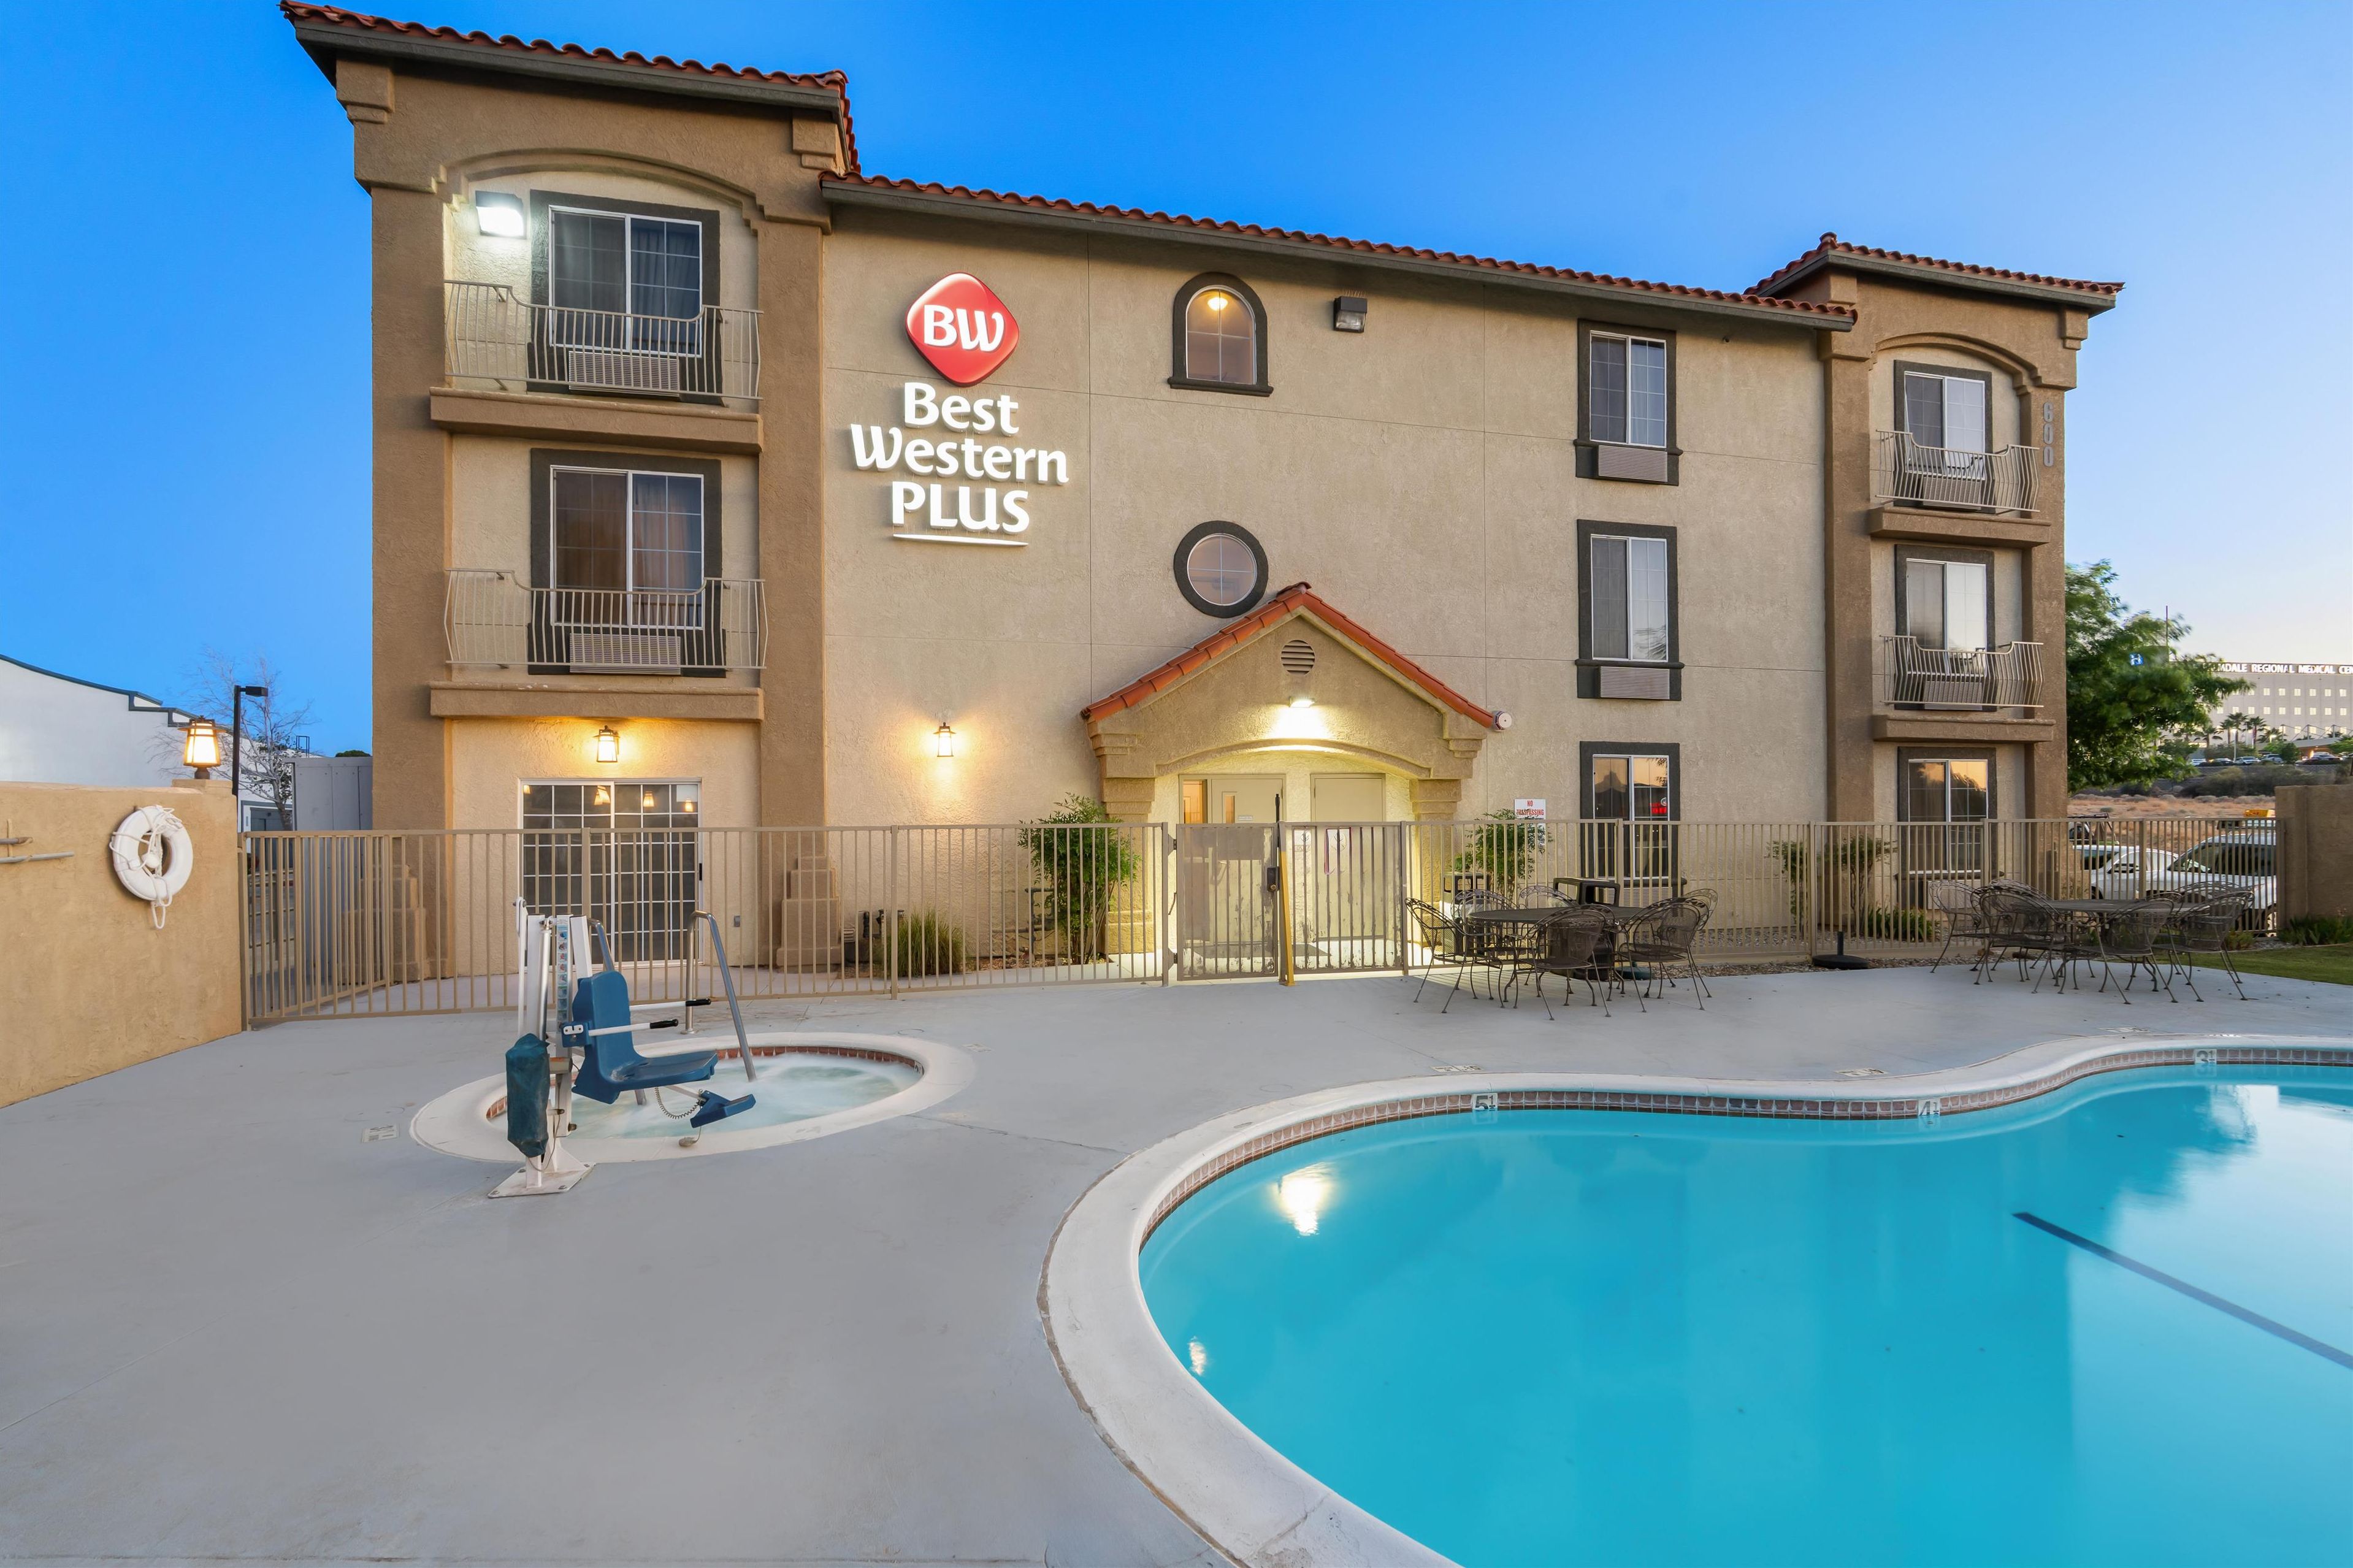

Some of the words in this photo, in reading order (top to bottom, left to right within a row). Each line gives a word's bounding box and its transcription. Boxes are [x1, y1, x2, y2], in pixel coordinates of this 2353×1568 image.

[924, 305, 1004, 351] BW
[905, 383, 1019, 436] Best
[2043, 402, 2054, 467] 600
[851, 424, 1069, 485] Western
[892, 481, 1030, 534] PLUS
[2203, 663, 2247, 672] MDALE
[2251, 664, 2295, 673] REGIONAL
[2298, 665, 2336, 674] MEDICAL
